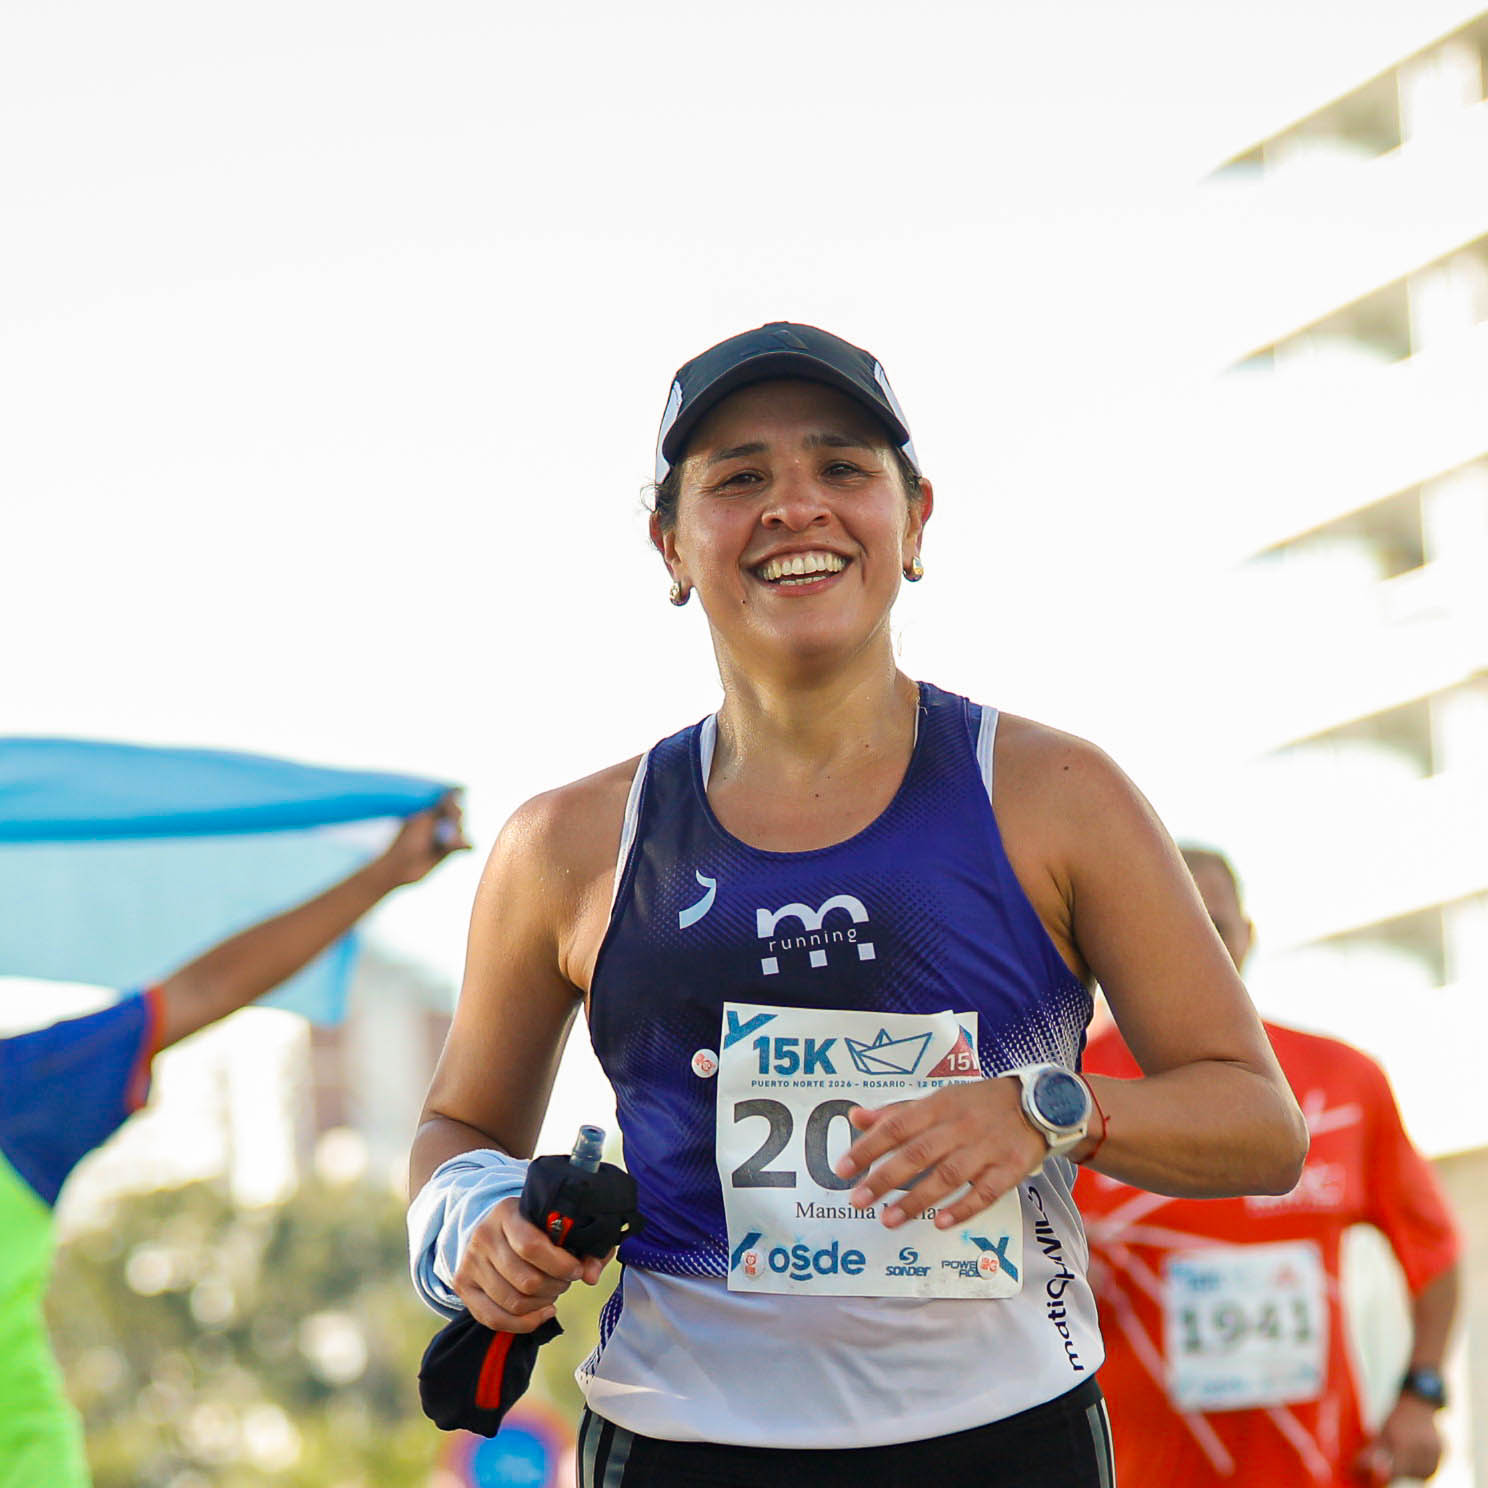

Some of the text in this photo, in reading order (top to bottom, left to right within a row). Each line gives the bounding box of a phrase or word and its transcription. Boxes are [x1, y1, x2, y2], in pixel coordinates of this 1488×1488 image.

[769, 928, 857, 952] running
[752, 1036, 838, 1075] 15K
[751, 1080, 790, 1088] PUERTO
[792, 1080, 826, 1088] NORTE
[828, 1080, 852, 1088] 2026
[863, 1080, 906, 1088] ROSARIO
[931, 1080, 944, 1088] DE
[731, 1098, 937, 1191] 20
[768, 1240, 866, 1278] osde
[941, 1260, 977, 1269] POWE
